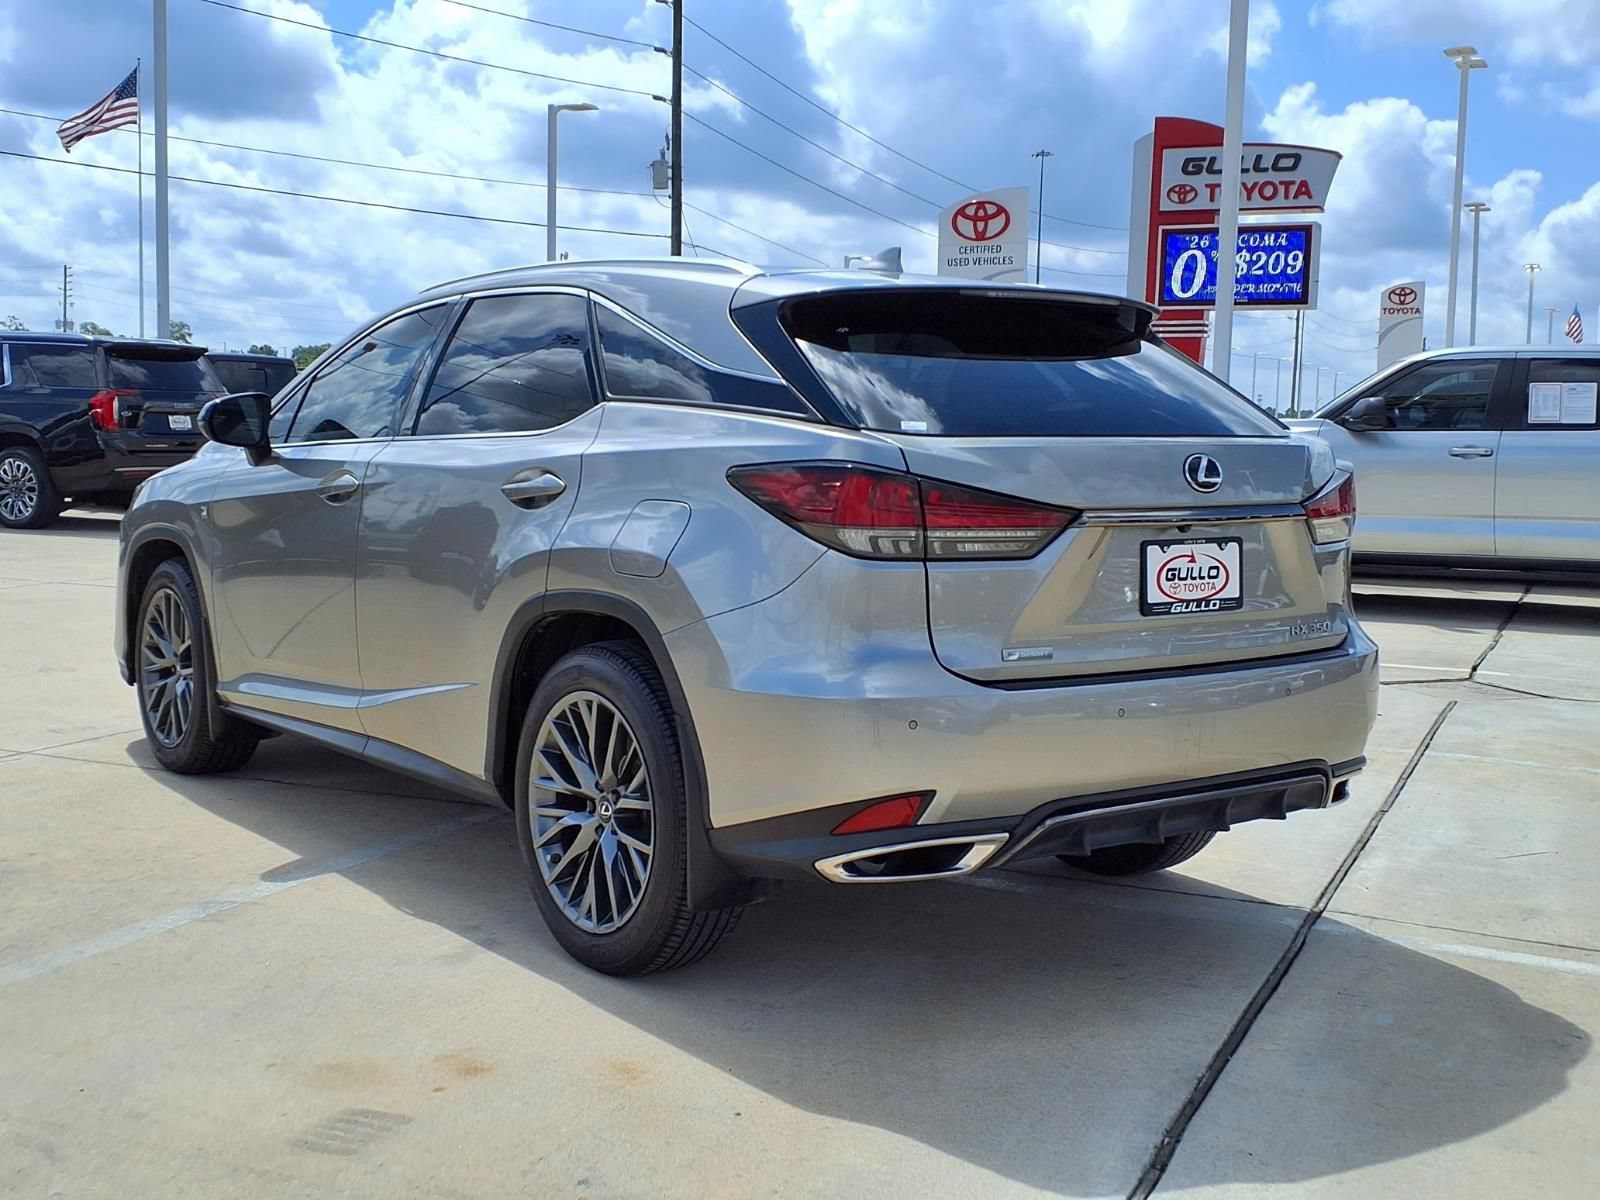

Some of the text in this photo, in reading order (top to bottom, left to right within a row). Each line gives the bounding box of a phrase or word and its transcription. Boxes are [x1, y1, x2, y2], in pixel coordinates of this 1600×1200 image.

[1204, 180, 1313, 203] TYOTA
[958, 244, 1002, 255] CERTIFIED
[947, 255, 1014, 267] USED VEHICLES
[1235, 249, 1304, 278] $209
[1382, 307, 1421, 315] TOYOTA
[1165, 565, 1220, 582] GULLO
[1183, 582, 1217, 593] TOYOTA
[1170, 600, 1220, 613] GULLO
